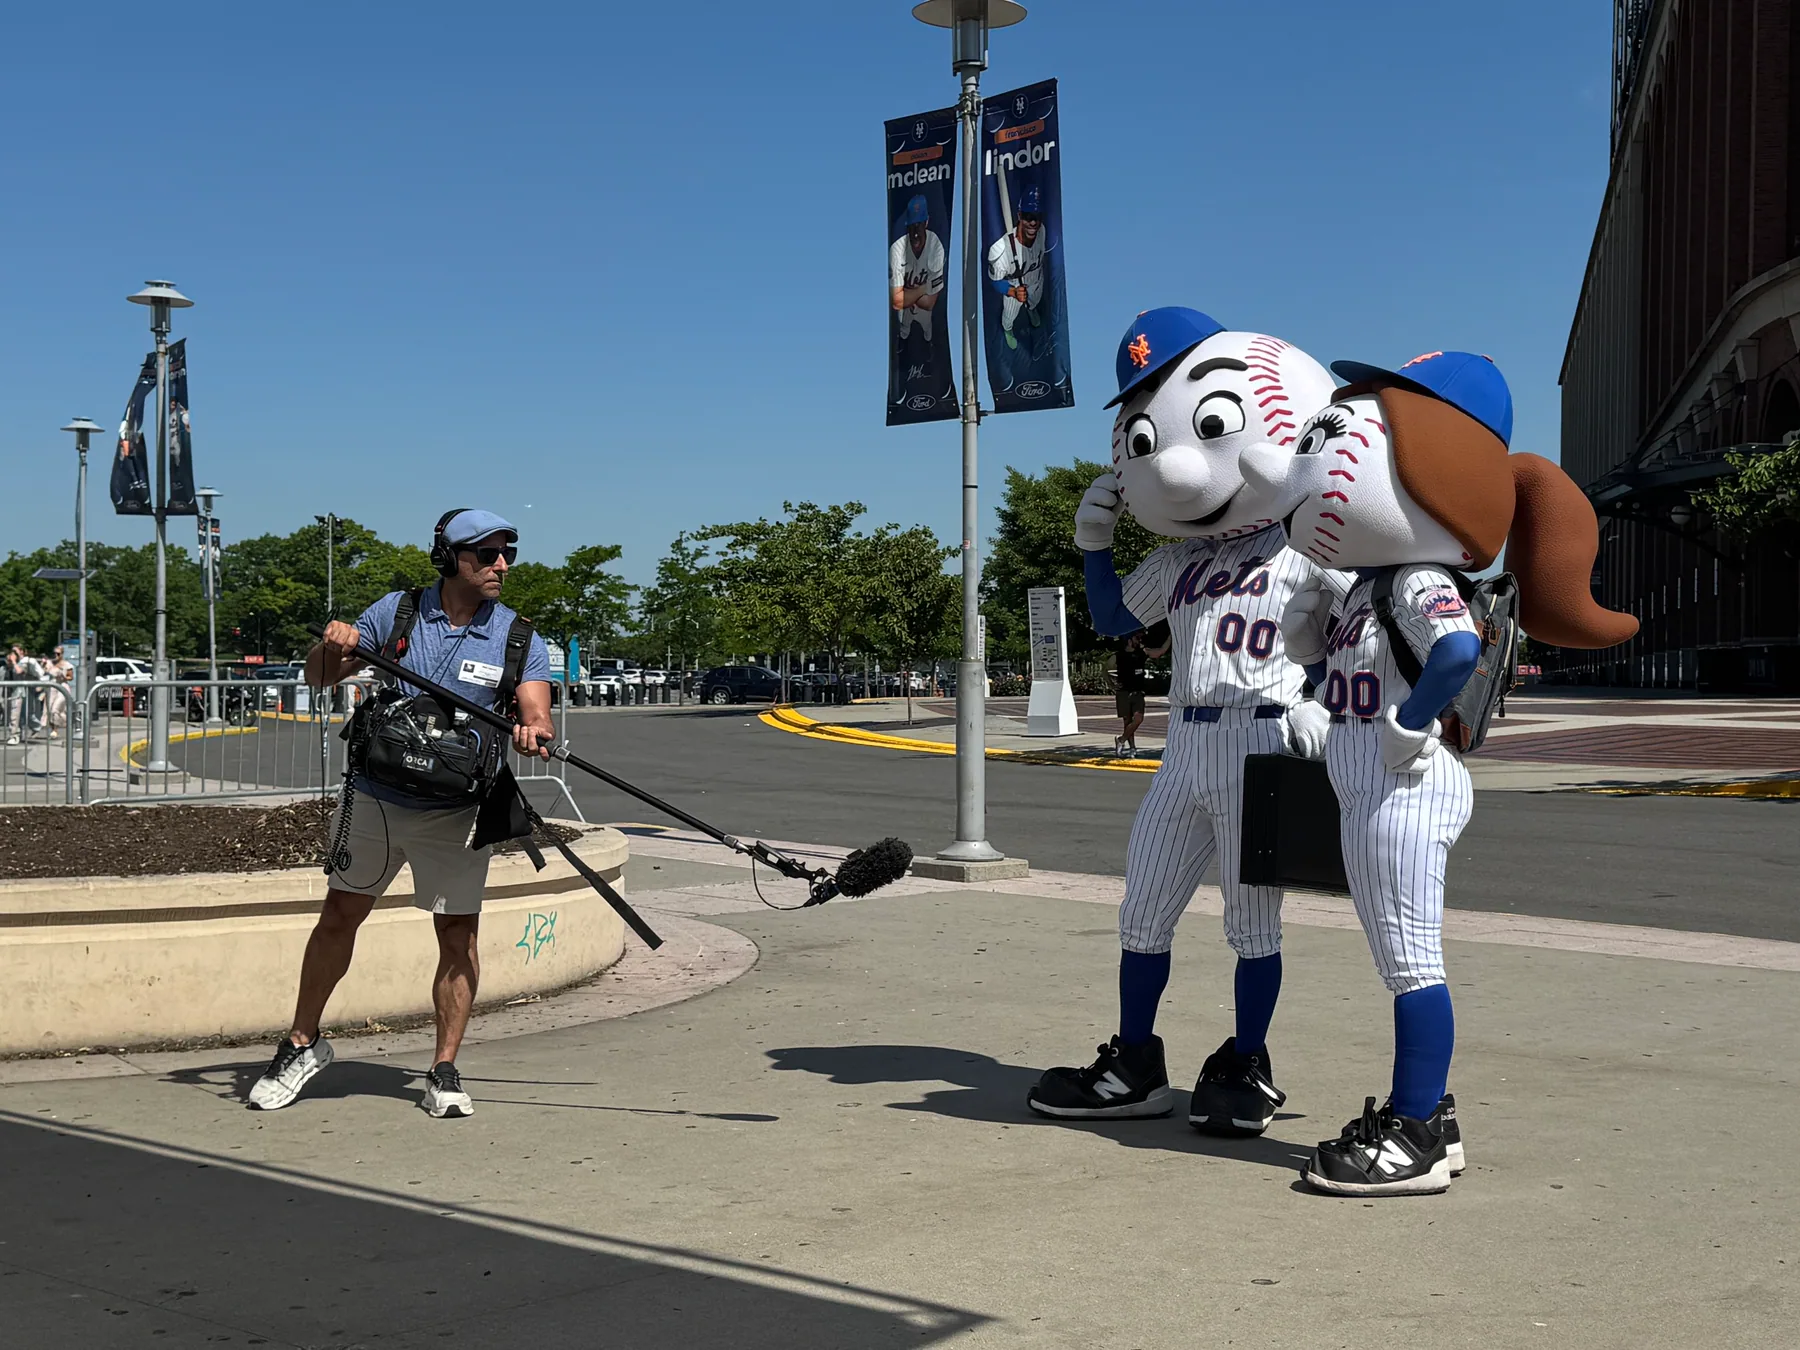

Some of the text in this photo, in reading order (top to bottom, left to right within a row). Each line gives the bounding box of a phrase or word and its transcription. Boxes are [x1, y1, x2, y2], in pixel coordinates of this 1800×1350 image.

[985, 140, 1056, 176] lindor
[888, 163, 951, 190] mclean
[912, 397, 931, 409] Ford
[1021, 383, 1045, 397] Ford
[1168, 556, 1272, 615] Mets
[1215, 612, 1278, 660] 00
[1324, 669, 1381, 718] 00
[405, 755, 428, 767] ORCA
[1364, 1139, 1414, 1175] N
